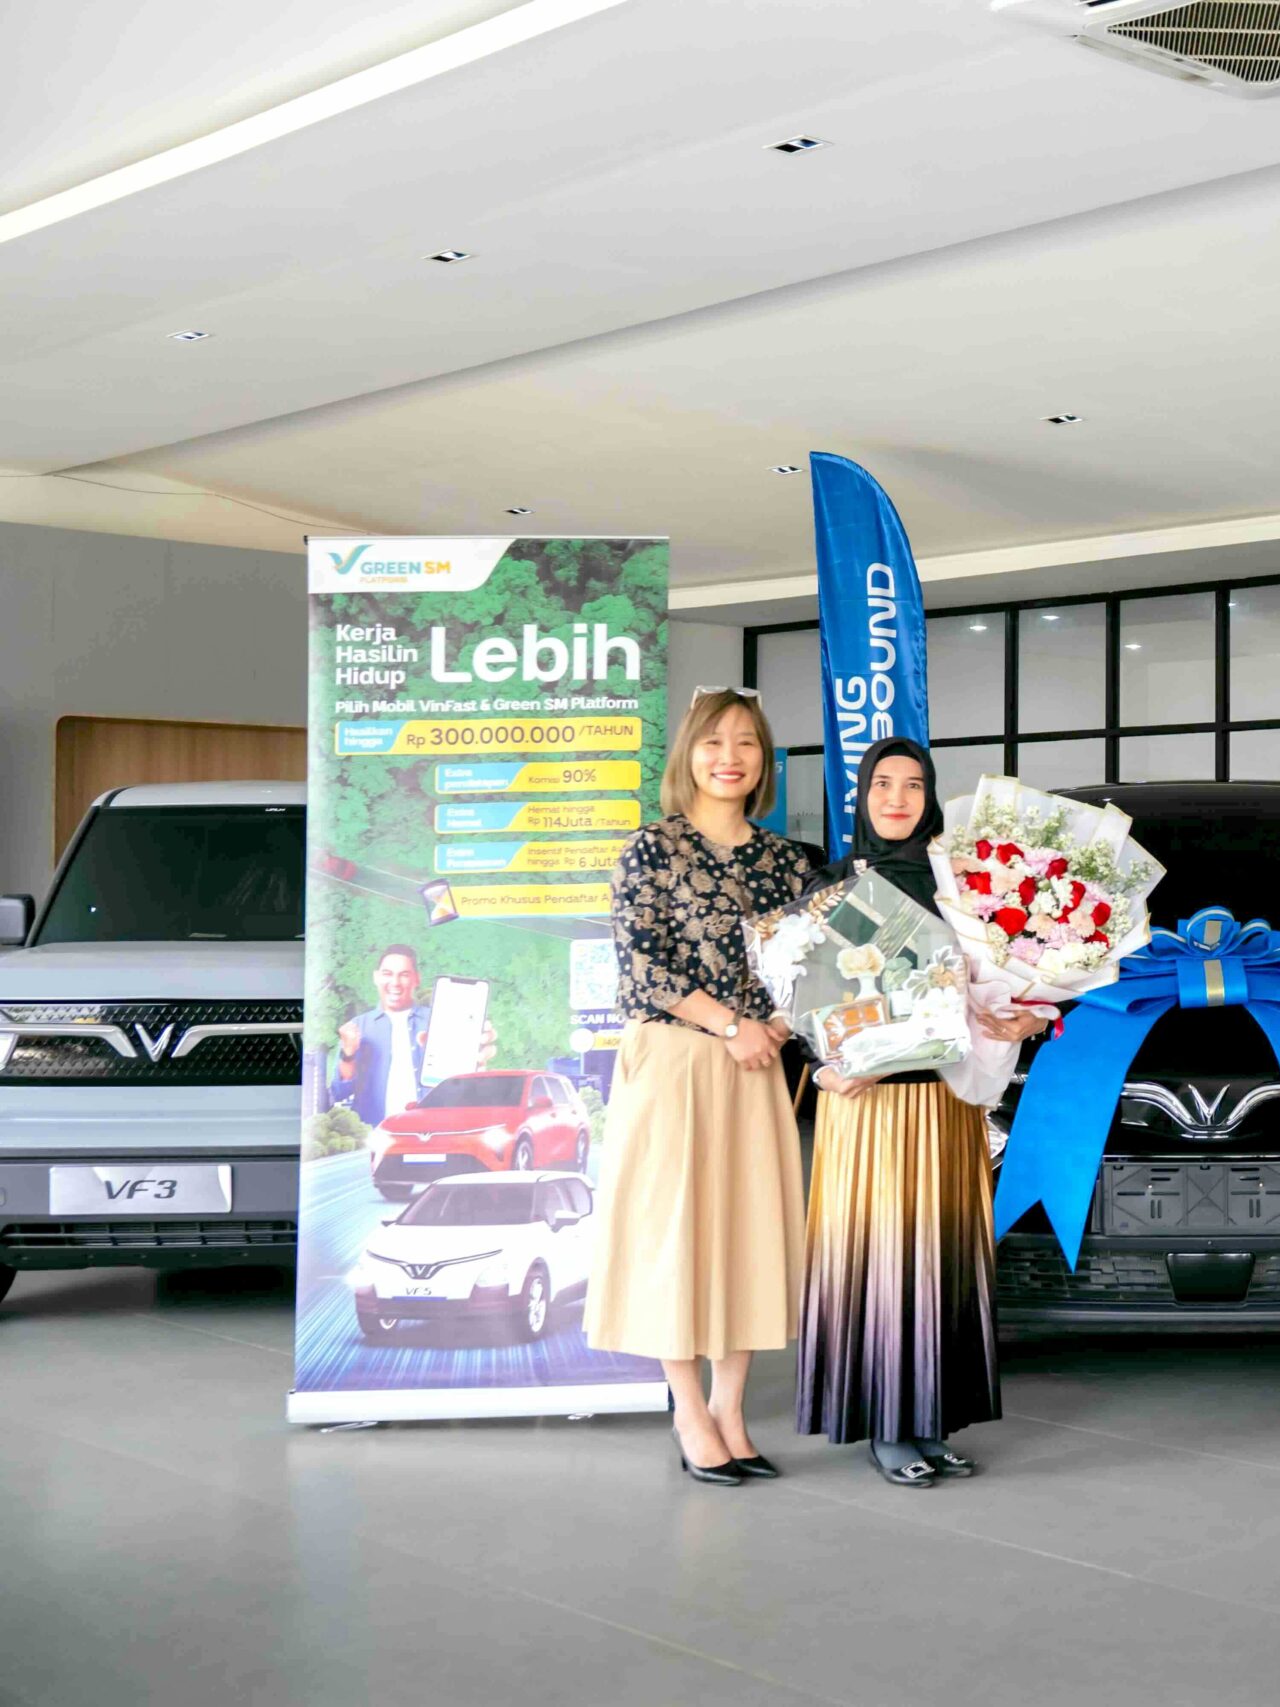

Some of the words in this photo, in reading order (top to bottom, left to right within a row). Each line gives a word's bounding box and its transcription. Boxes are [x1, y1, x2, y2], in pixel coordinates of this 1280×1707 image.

[360, 561, 422, 575] GREEN
[424, 561, 451, 574] SM
[336, 623, 397, 645] Kerja
[336, 645, 418, 663] Hasilin
[431, 624, 641, 683] Lebih
[866, 562, 898, 742] BOUND
[336, 667, 406, 690] Hidup
[335, 701, 370, 713] Pilih
[372, 700, 417, 712] Mobil
[419, 700, 477, 712] VinFast
[480, 699, 491, 711] &
[493, 699, 540, 711] Green
[543, 698, 568, 709] SM
[571, 697, 639, 709] Platform
[406, 734, 426, 748] Rp
[430, 726, 575, 745] 300.000.000
[578, 725, 634, 737] /TAHUN
[562, 769, 597, 783] 90%
[578, 857, 587, 868] 6
[461, 896, 497, 906] Promo
[500, 895, 541, 905] Khusus
[544, 893, 598, 904] Pendaftar
[570, 1013, 605, 1025] SCAN
